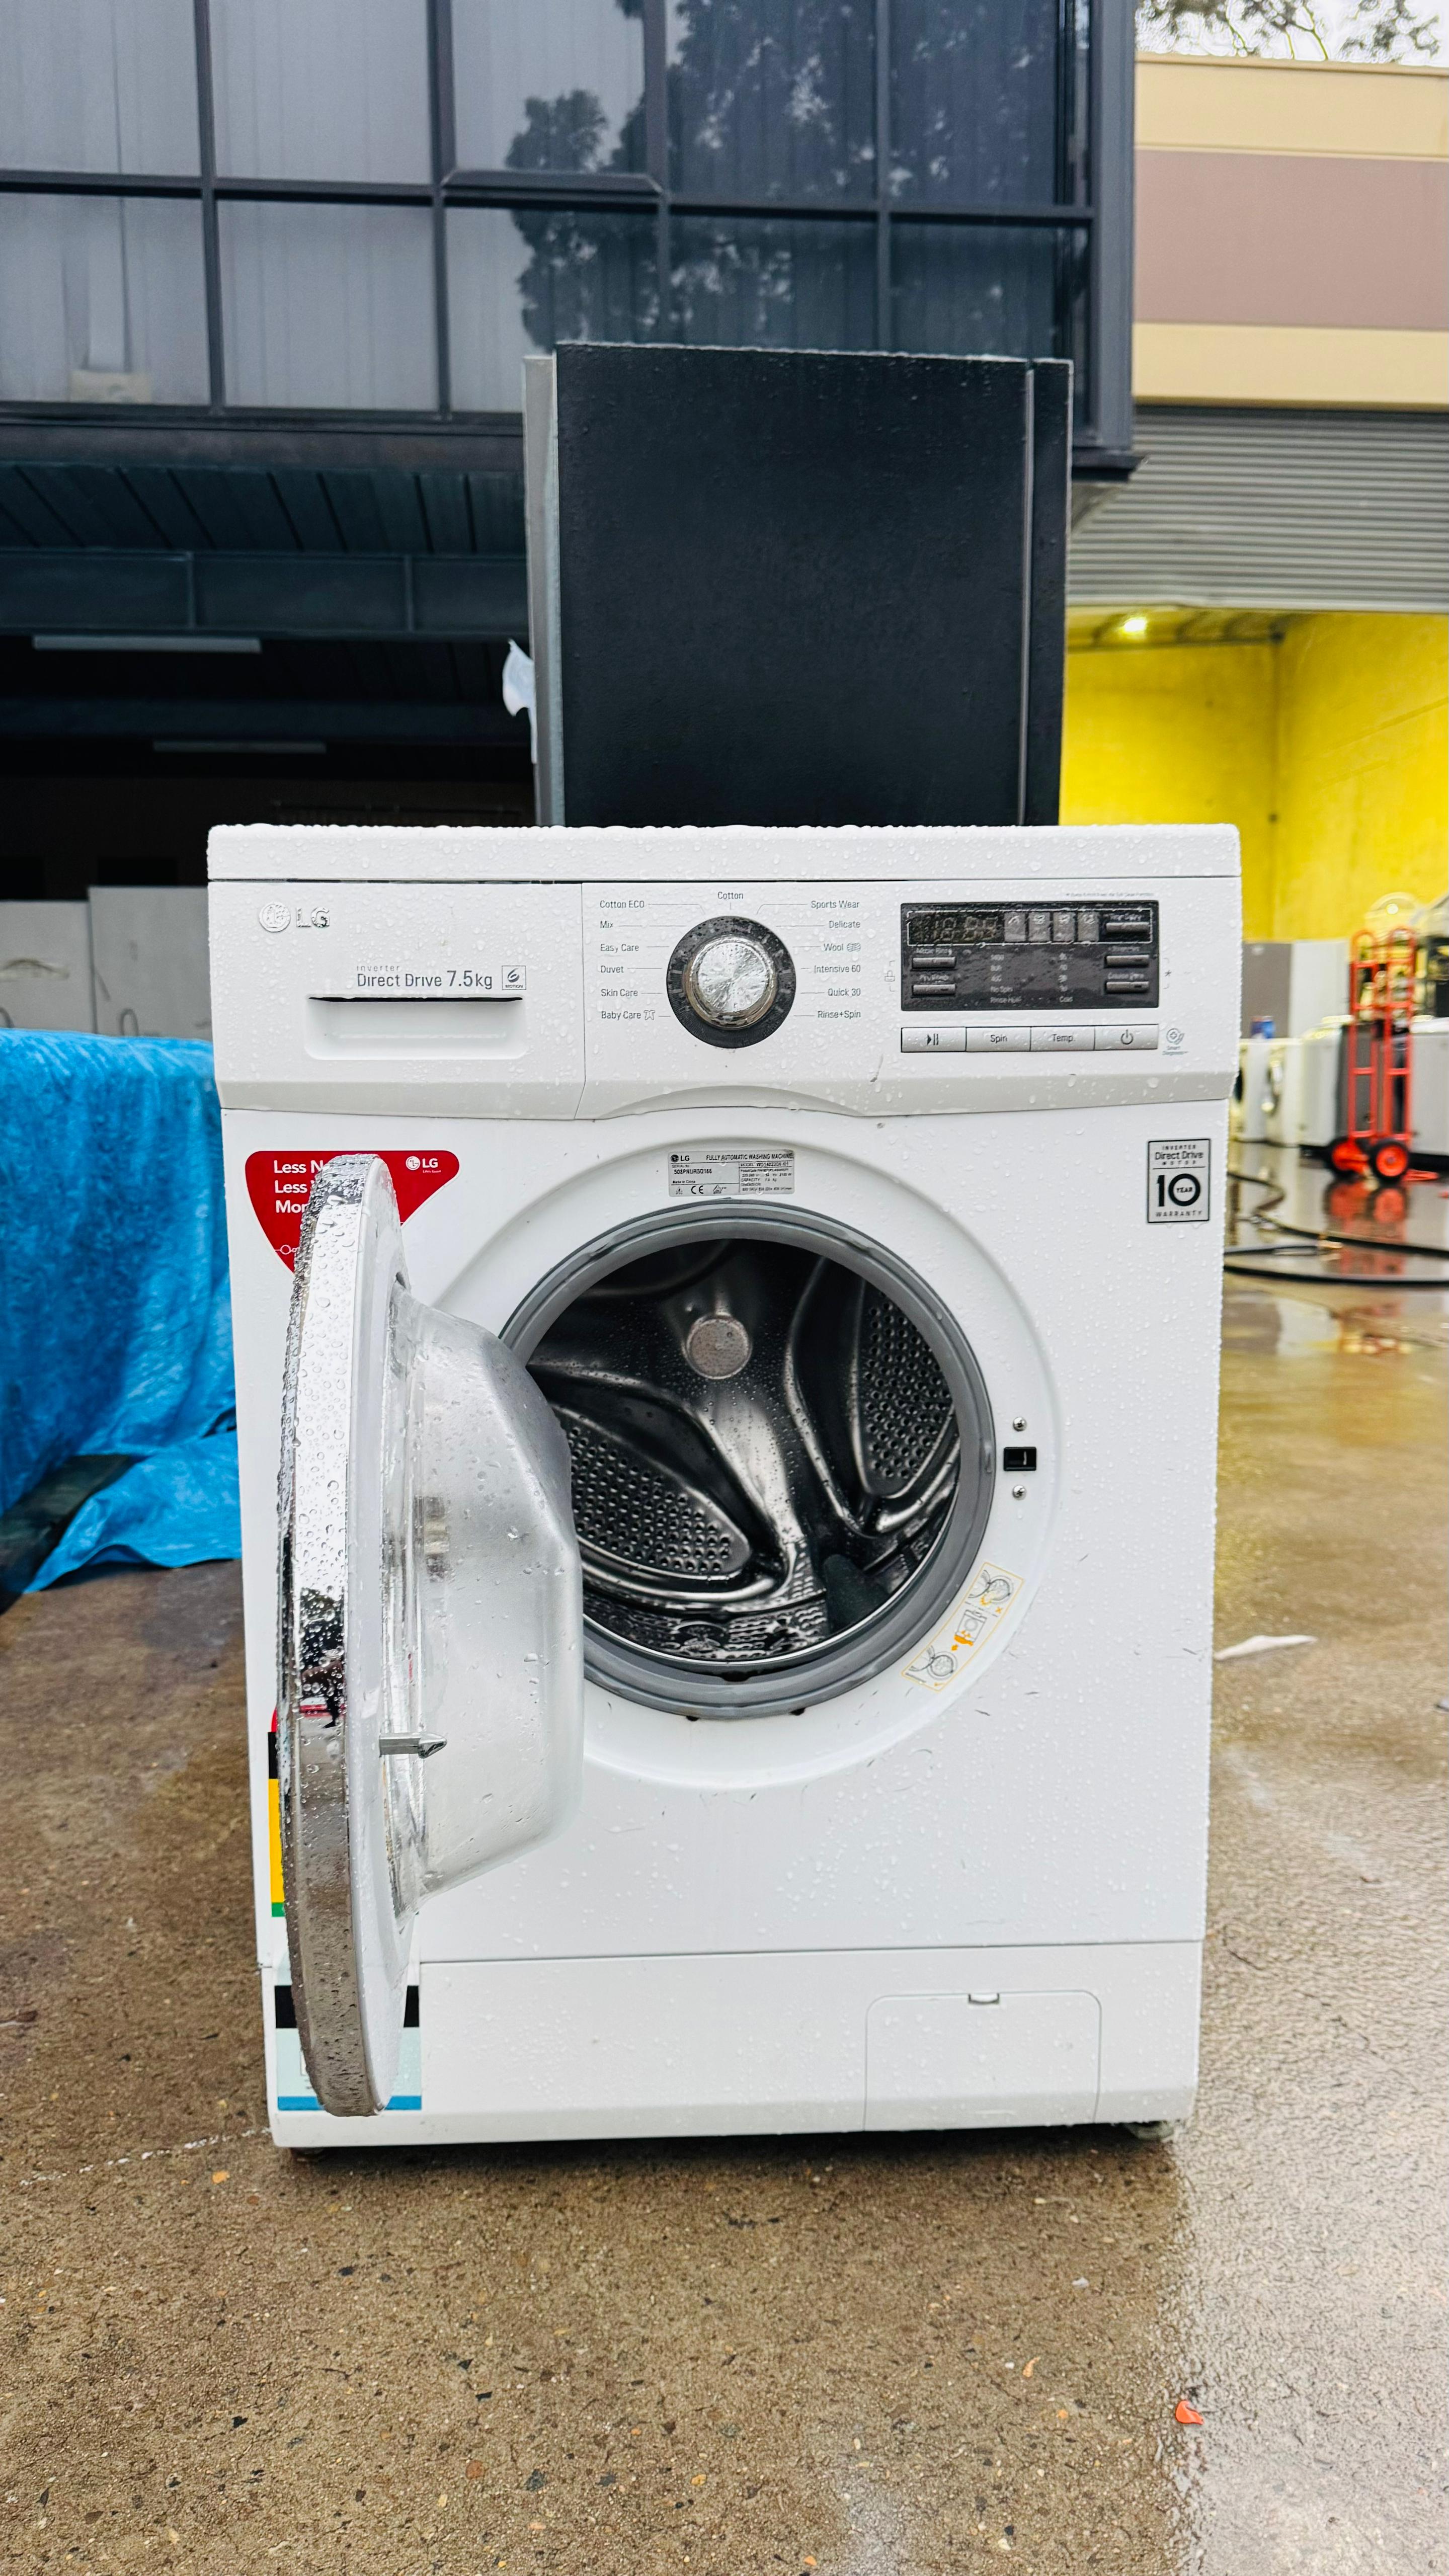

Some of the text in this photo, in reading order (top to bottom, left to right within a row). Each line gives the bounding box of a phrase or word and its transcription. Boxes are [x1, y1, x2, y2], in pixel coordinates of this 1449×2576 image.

[717, 891, 744, 900] Cotton
[600, 900, 645, 909] Cotton ECO
[811, 900, 860, 910] Sports Wear
[296, 907, 330, 928] LG
[600, 920, 614, 929] Mix
[829, 920, 861, 928] Delicate
[600, 943, 639, 953] Easy Care
[823, 942, 844, 951] Wool
[600, 965, 624, 974] Duvet
[814, 964, 861, 974] Intensive 60
[357, 973, 400, 987] Direct
[405, 973, 443, 987] Drive
[601, 988, 638, 997] Skin Care
[828, 988, 861, 998] Quick 30
[601, 1010, 641, 1020] Baby Care
[817, 1010, 861, 1020] Rinse+Spin
[990, 1033, 1008, 1043] Spin
[1155, 1151, 1204, 1160] Direct Drive
[274, 1160, 306, 1174] Less
[422, 1158, 438, 1168] LG
[274, 1180, 307, 1193] Less
[1156, 1173, 1201, 1207] 10
[276, 1199, 308, 1213] Mor
